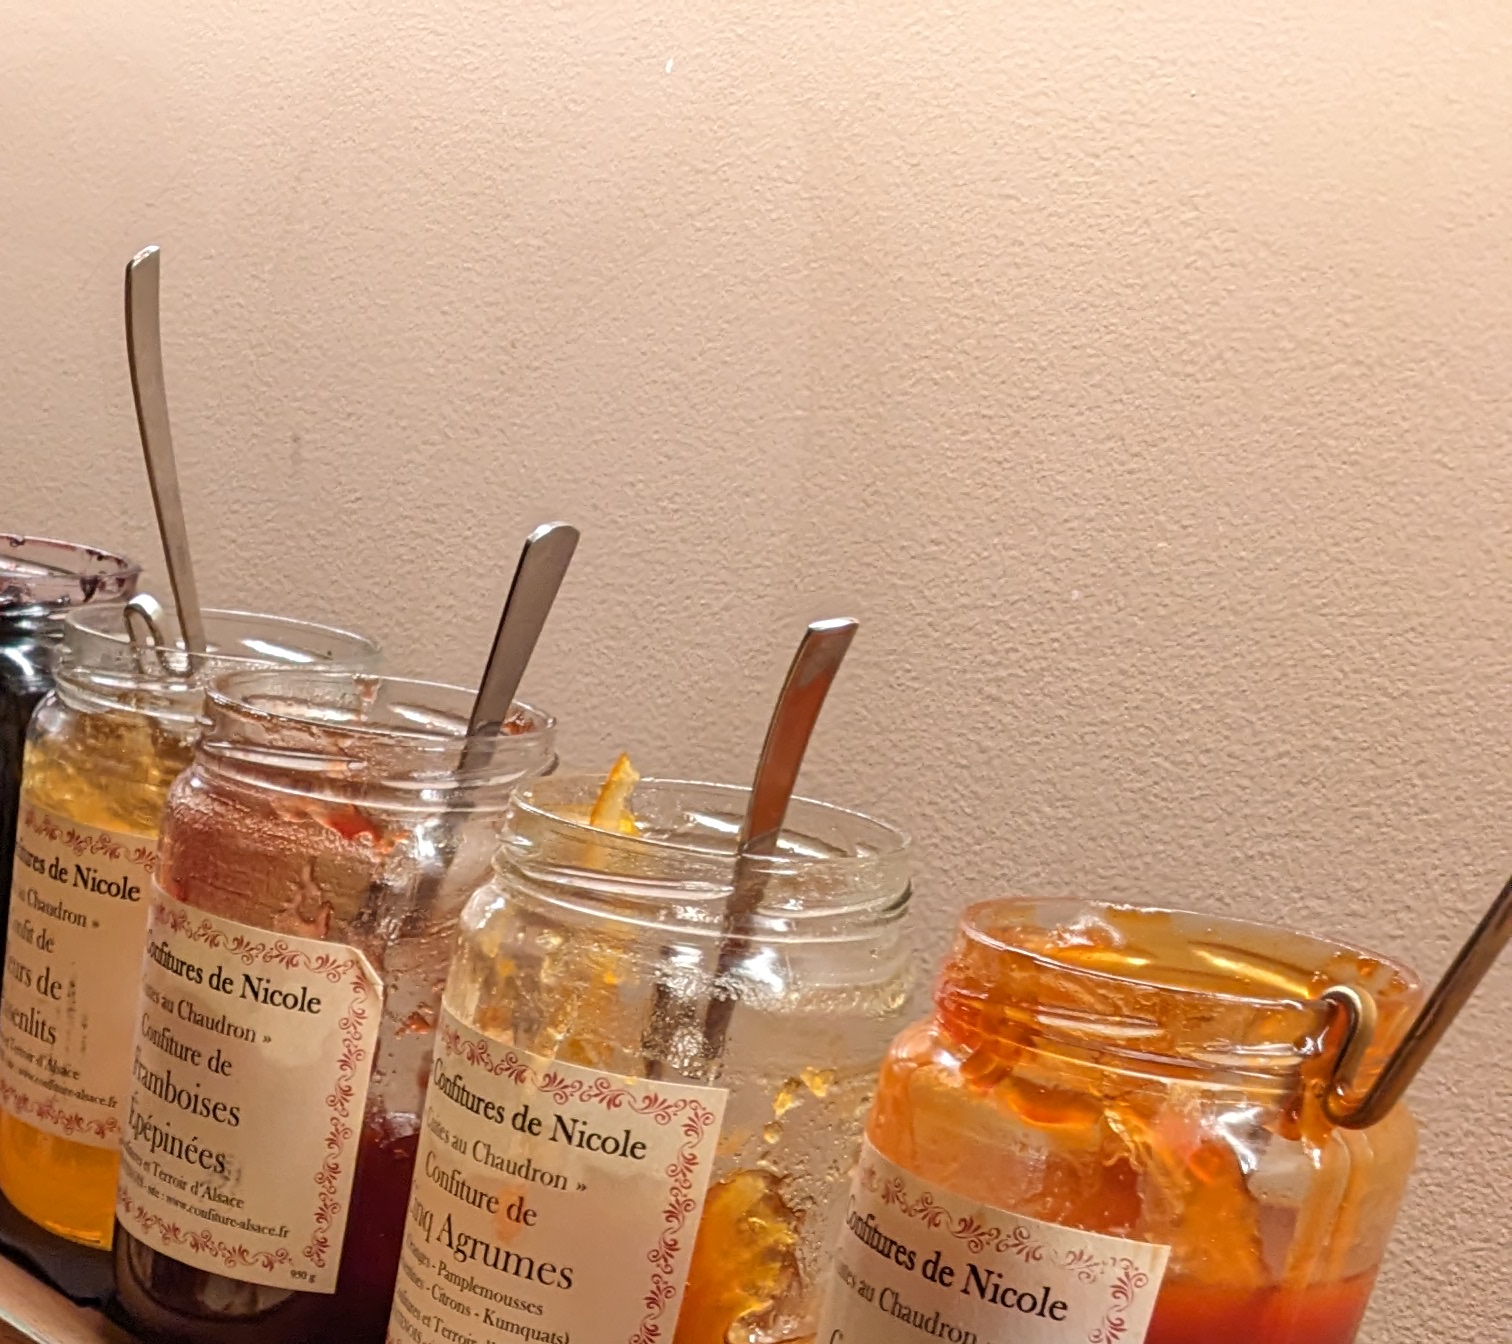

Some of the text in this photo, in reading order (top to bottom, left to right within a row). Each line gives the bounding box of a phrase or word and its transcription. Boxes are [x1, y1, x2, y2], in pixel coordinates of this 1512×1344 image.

[48, 856, 68, 883] de
[72, 863, 141, 902] Nicole
[27, 888, 87, 928] Chaudron
[36, 928, 54, 953] de
[36, 966, 62, 1000] de
[208, 965, 234, 994] de
[240, 973, 321, 1015] Nicole
[141, 1012, 232, 1077] Confiture de
[177, 998, 256, 1044] Chaudron
[433, 1057, 647, 1160] Confitures de Nicole
[425, 1150, 537, 1226] Confiture de
[451, 1136, 467, 1154] au
[472, 1139, 567, 1191] Chaudron
[190, 1181, 244, 1209] d'Alsace
[436, 1213, 574, 1290] Agrumes
[431, 1283, 471, 1317] Citrons
[437, 1260, 543, 1316] Pamplemousses
[922, 1251, 954, 1287] de
[961, 1263, 1068, 1321] Nicole
